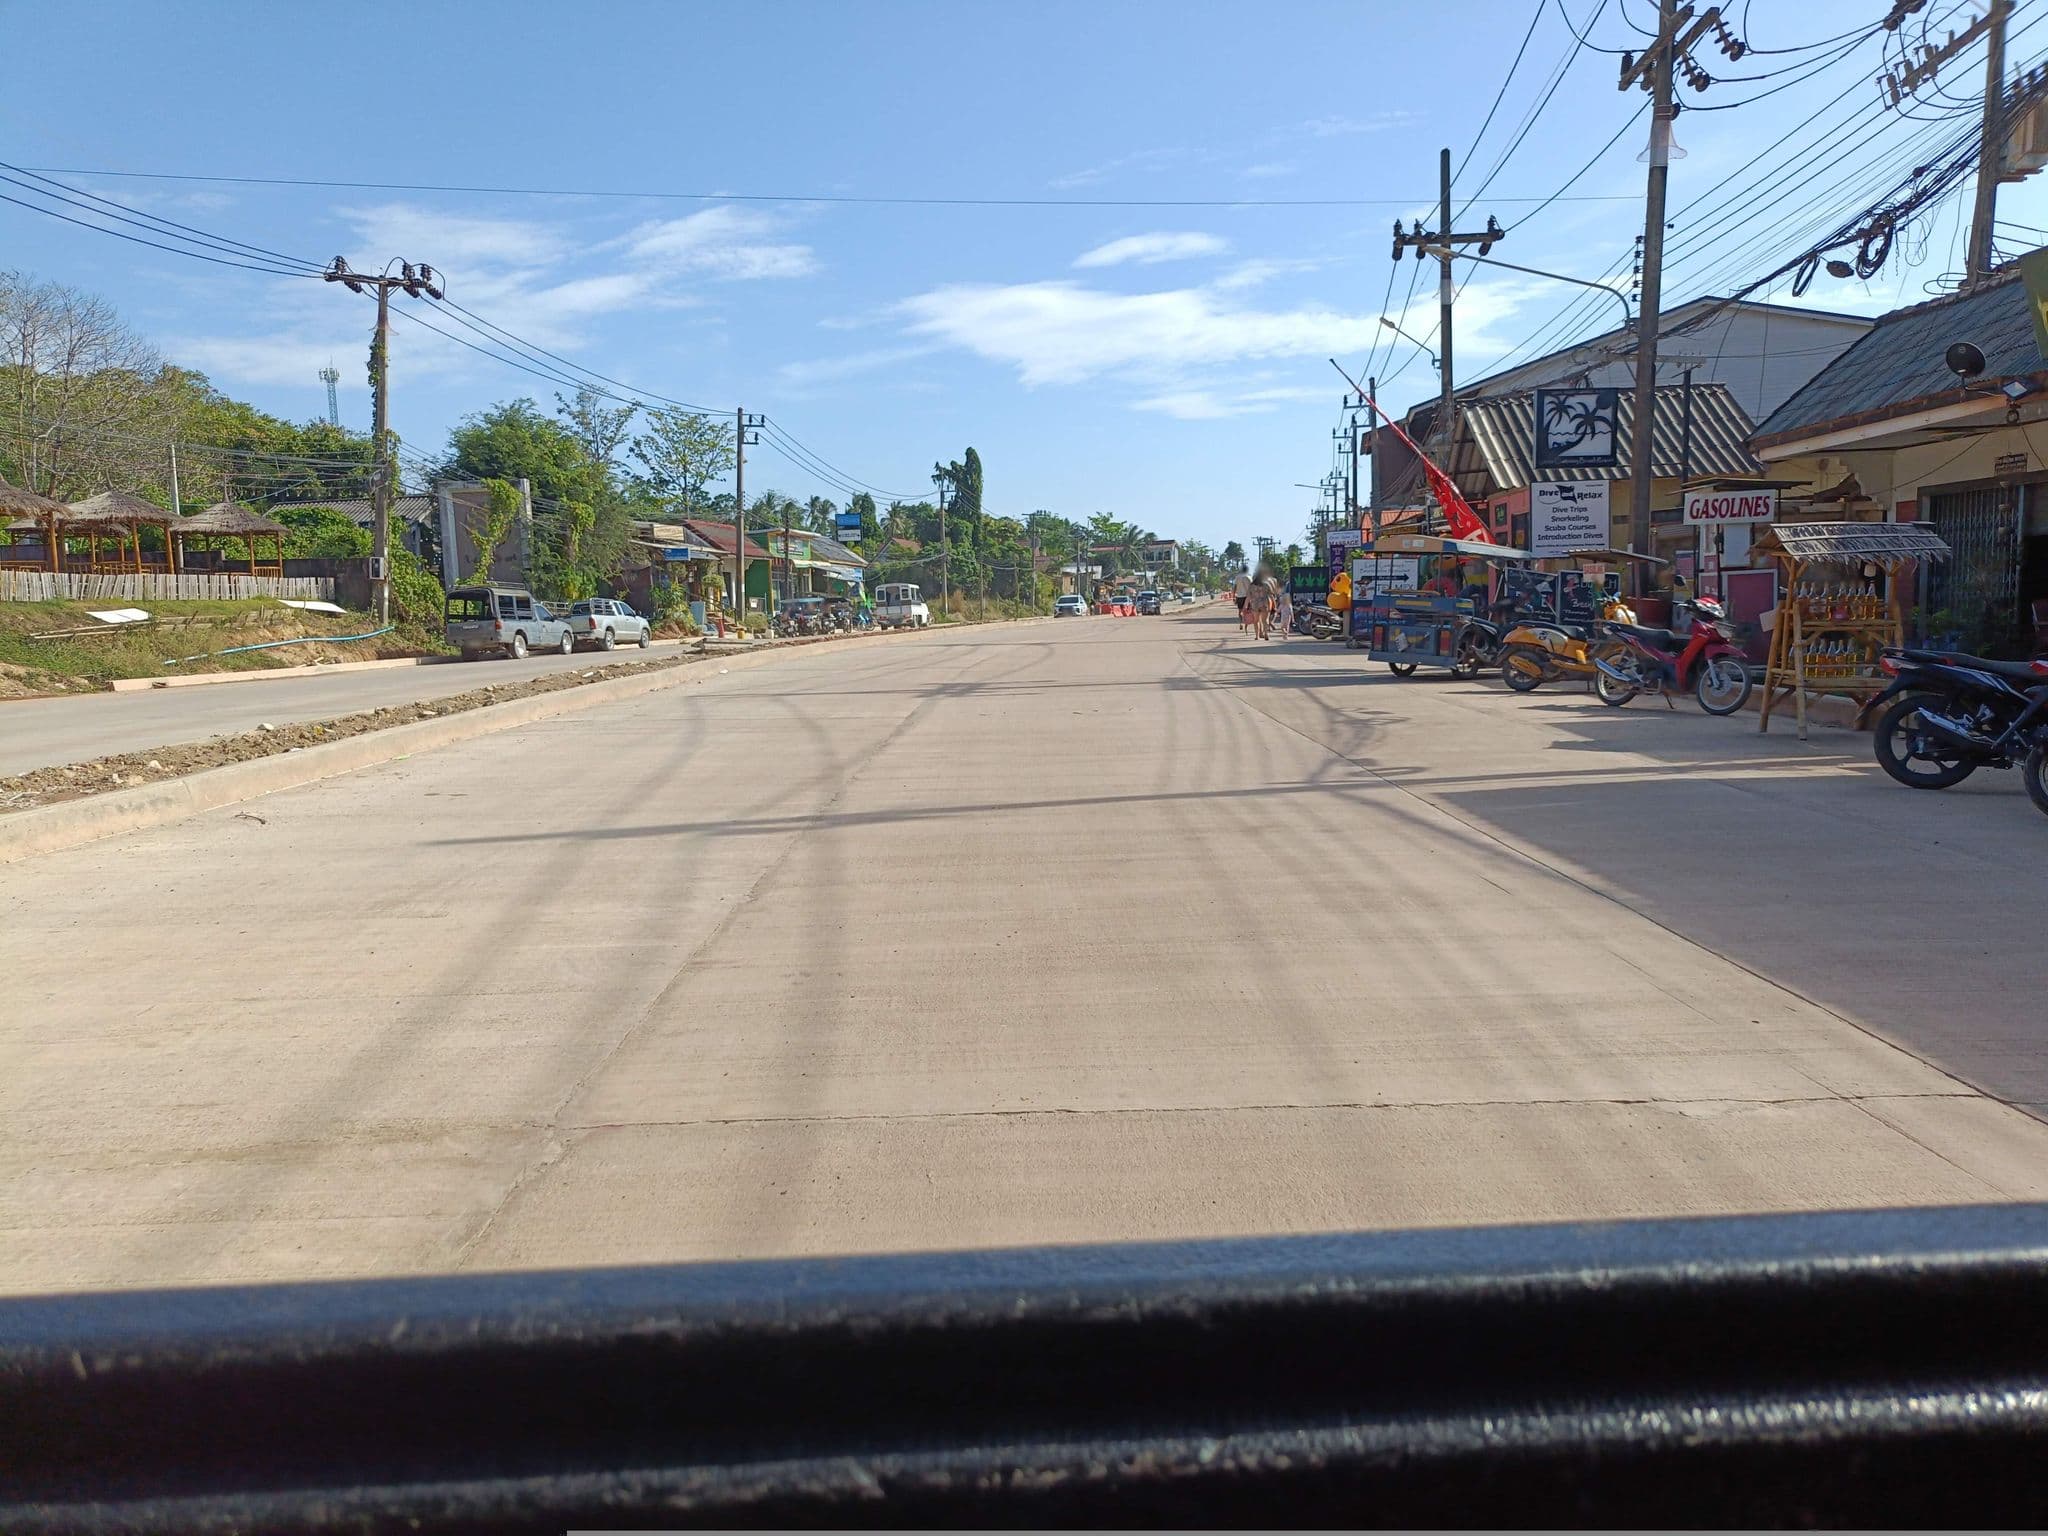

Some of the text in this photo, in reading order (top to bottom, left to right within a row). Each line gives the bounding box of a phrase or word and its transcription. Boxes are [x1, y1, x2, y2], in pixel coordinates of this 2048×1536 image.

[1539, 489, 1559, 497] Dive
[1577, 492, 1603, 500] Relax
[1689, 496, 1770, 520] GASOLINES
